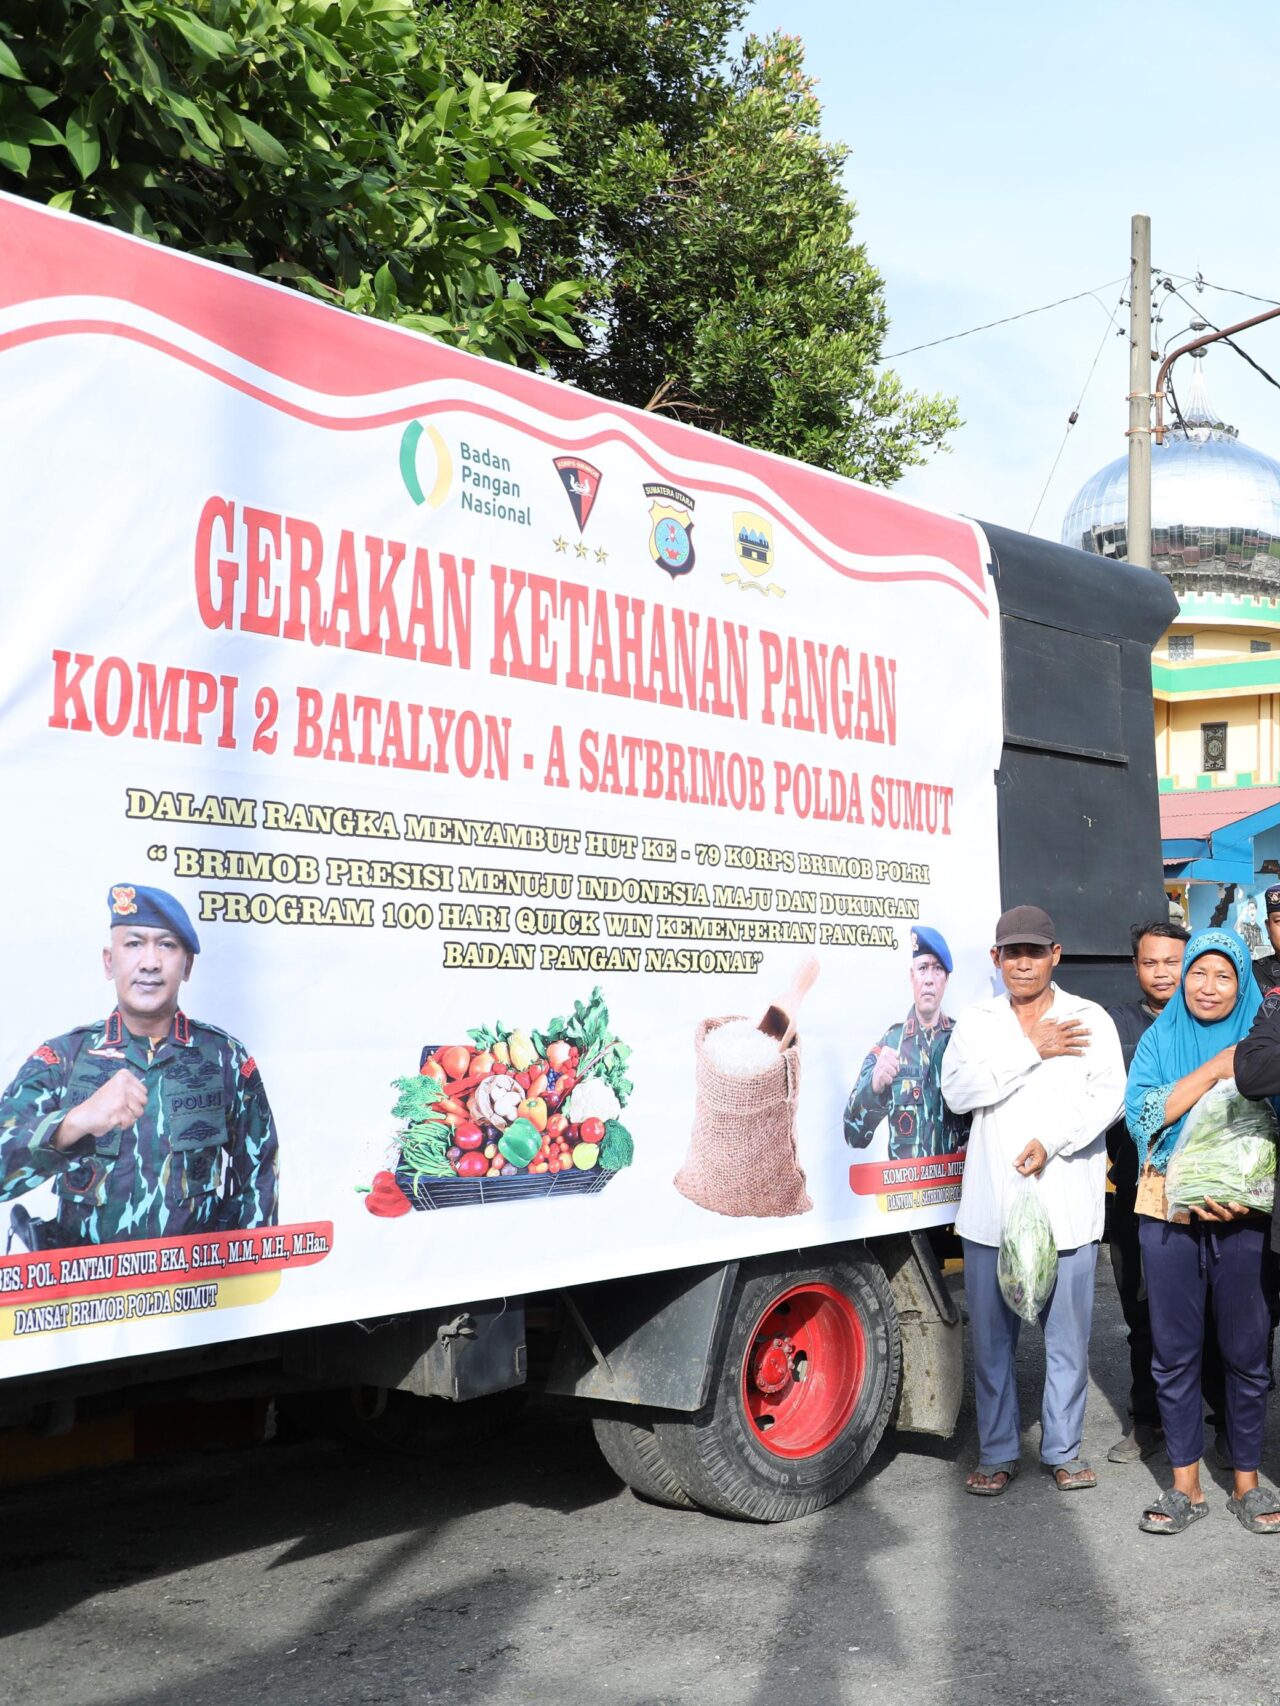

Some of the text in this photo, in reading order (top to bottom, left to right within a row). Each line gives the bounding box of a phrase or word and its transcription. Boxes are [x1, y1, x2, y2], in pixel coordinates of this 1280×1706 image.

[460, 441, 510, 472] Badan
[461, 465, 520, 498] Pangan
[461, 490, 531, 526] Nasional
[645, 486, 694, 508] SUMATERA UTARA
[194, 495, 897, 746] GERAKAN KETAHANAN PANGAN
[48, 649, 239, 749] KOMPI
[252, 686, 279, 755] 2
[293, 686, 512, 781] BATALYON
[544, 725, 570, 788] A
[579, 728, 766, 812] SATBRIMOB
[774, 760, 865, 825] POLDA
[871, 776, 954, 836] SUMUT
[126, 788, 256, 827] DALAM
[263, 802, 400, 839] RANGKA
[405, 815, 580, 854] MENYAMBUT
[585, 832, 637, 859] HUT
[642, 837, 676, 862] KE
[695, 844, 720, 866] 79
[725, 847, 795, 872] KORPS
[798, 853, 873, 879] BRIMOB
[876, 861, 931, 884] POLRI
[175, 848, 319, 883] BRIMOB
[327, 857, 453, 892] PRESISI
[459, 867, 572, 899] MENUJU
[578, 875, 708, 906] INDONESIA
[713, 885, 772, 911] MAJU
[776, 890, 817, 914] DAN
[821, 894, 919, 919] DUKUNGAN
[199, 892, 899, 950] PROGRAM 100 HARI QUICK WIN KEMENTERIAN PANGAN,
[443, 942, 535, 970] BADAN
[540, 945, 640, 972] PANGAN
[883, 1165, 919, 1184] KOMPOL
[947, 1161, 965, 1176] MUH
[26, 1262, 57, 1289] POL.
[60, 1254, 115, 1284] RANTAU
[117, 1252, 157, 1276] ISNUR
[160, 1248, 189, 1273] EKA,
[292, 1232, 330, 1256] M.Han.
[14, 1284, 219, 1335] DANSAT BRIMOB POLDA SUMUT
